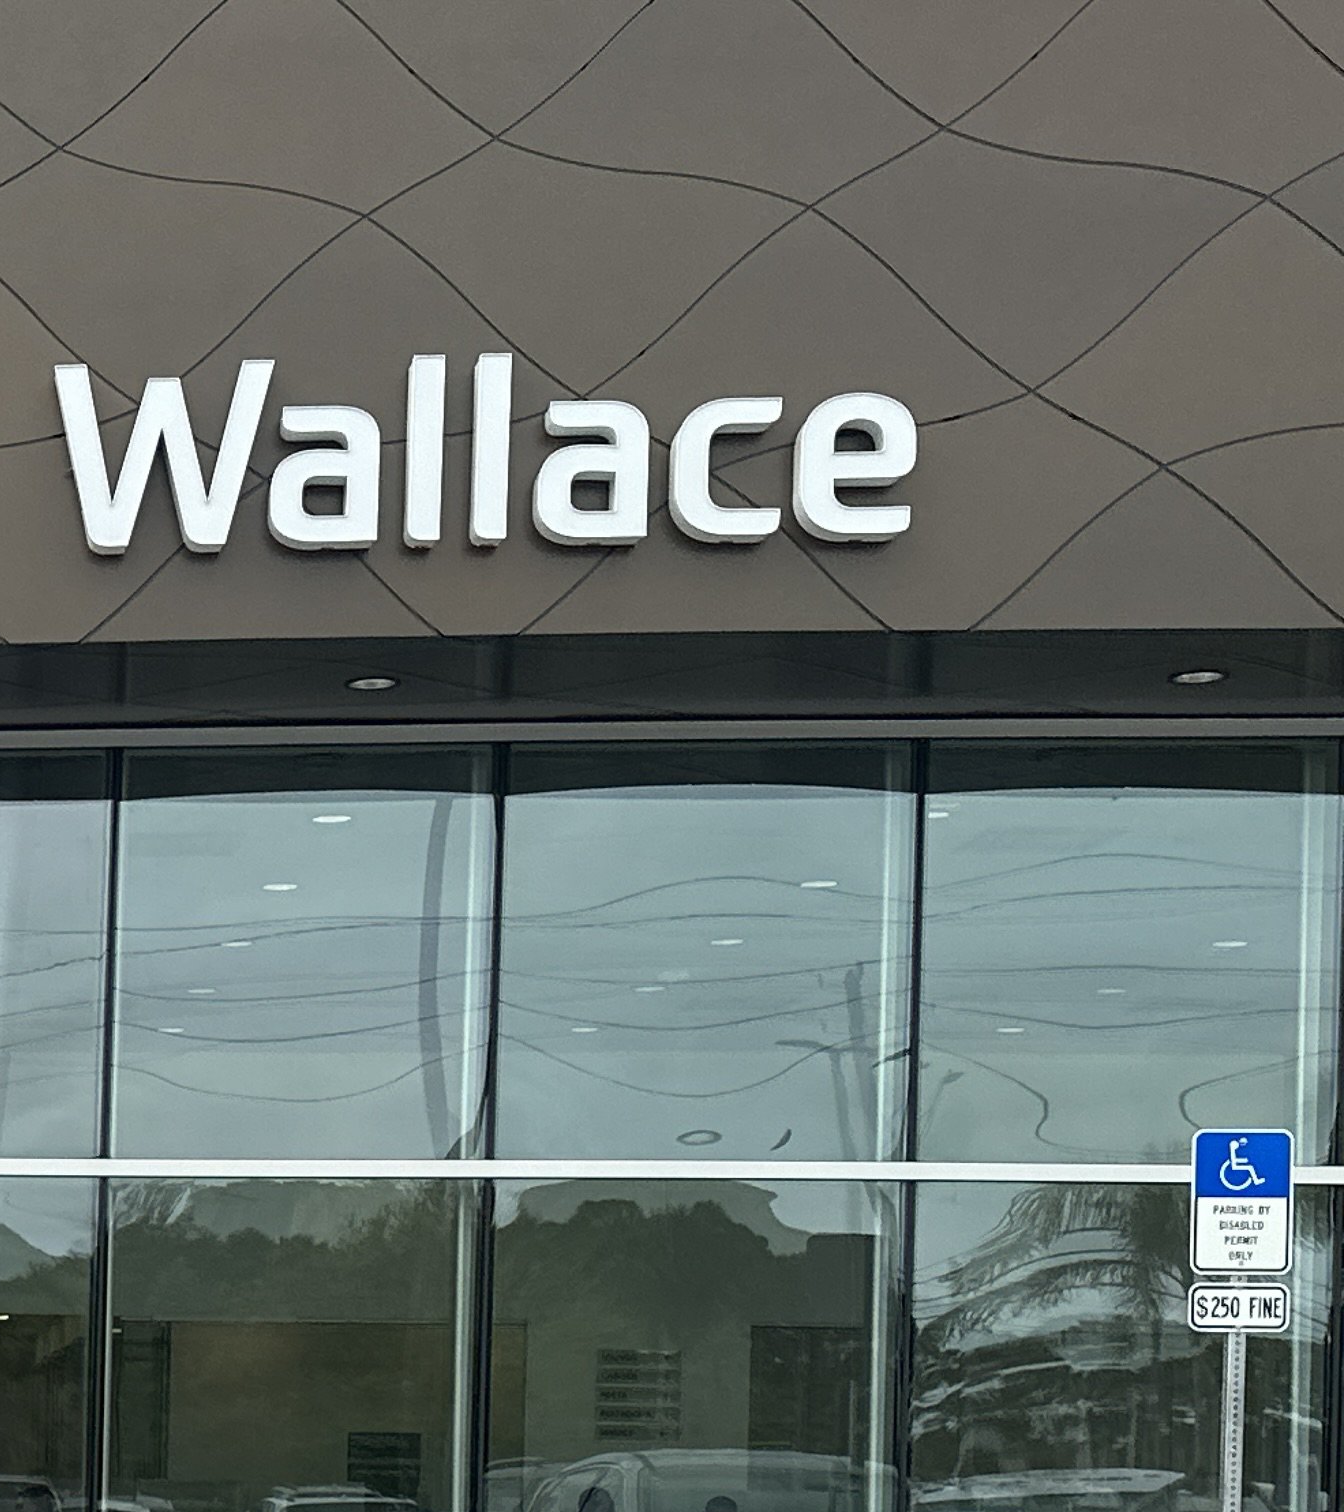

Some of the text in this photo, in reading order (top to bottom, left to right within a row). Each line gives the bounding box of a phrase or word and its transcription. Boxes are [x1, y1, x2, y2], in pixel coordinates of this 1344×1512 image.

[54, 352, 918, 554] Wallace
[1213, 1205, 1271, 1215] PARKING BY
[1219, 1220, 1264, 1231] DISABLED
[1224, 1235, 1258, 1245] PERMIT
[1228, 1251, 1253, 1261] ONLY
[1196, 1295, 1282, 1320] $250 FINE
